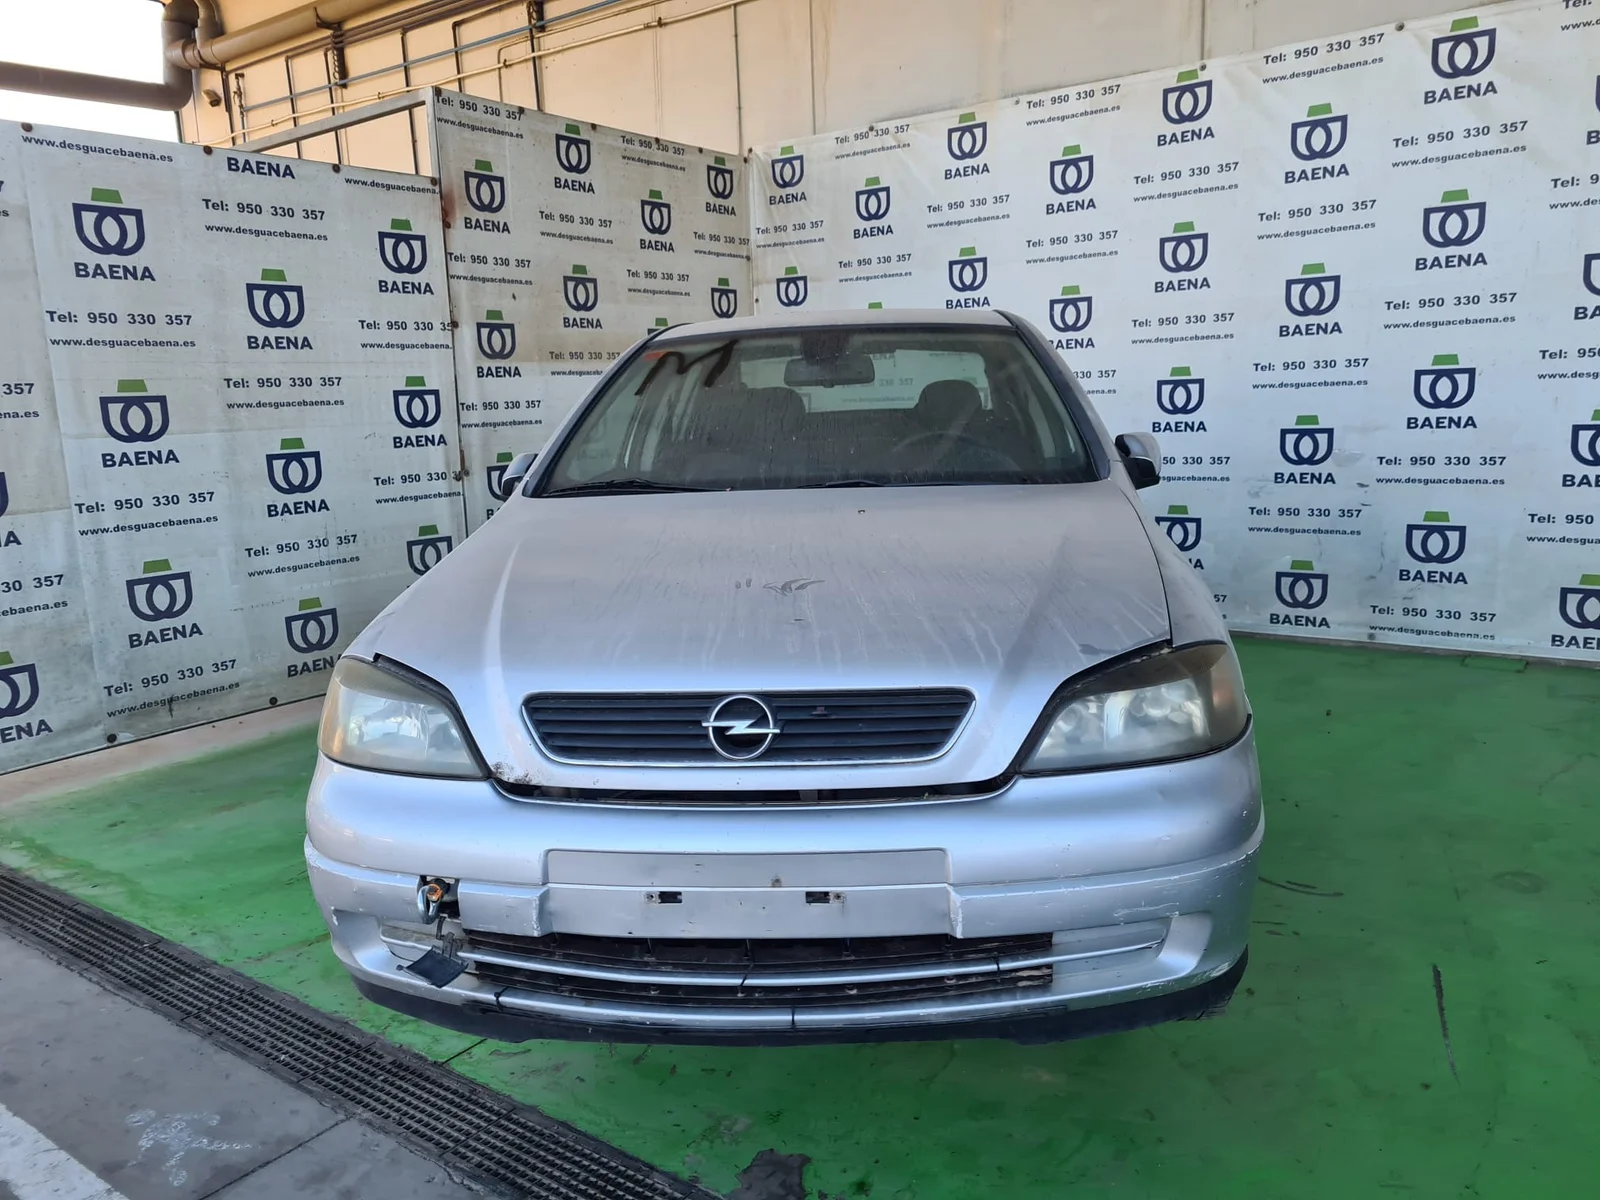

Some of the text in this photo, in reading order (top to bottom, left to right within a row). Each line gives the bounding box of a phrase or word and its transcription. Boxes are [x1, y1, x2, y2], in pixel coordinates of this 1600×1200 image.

[1263, 32, 1385, 65] Tel: 950 330 357
[1262, 57, 1384, 84] www.desguacebaena.es
[1026, 84, 1121, 109] Tel: 950 330 357
[1424, 81, 1498, 105] BAENA
[435, 95, 523, 121] Tel: 950 330 357
[1026, 105, 1120, 126] www.desguacebaena.es
[436, 115, 524, 139] www.desguacebaena.es
[1392, 120, 1528, 148] Tel: 950 330 357
[1157, 126, 1215, 147] BAENA
[21, 135, 173, 162] www.desguacebaena.es
[1391, 145, 1526, 168] www.desguacebaena.es
[226, 156, 296, 180] BAENA
[944, 163, 990, 180] BAENA
[1133, 161, 1239, 185] Tel: 950 330 357
[1284, 163, 1350, 184] BAENA
[554, 176, 595, 195] BAENA
[1133, 184, 1238, 202] www.desguacebaena.es
[769, 191, 807, 206] BAENA
[927, 194, 1010, 213] Tel: 950 330 357
[1046, 198, 1097, 215] BAENA
[201, 198, 325, 221] Tel: 950 330 357
[705, 201, 737, 217] BAENA
[1258, 199, 1377, 222] Tel: 950 330 357
[464, 216, 511, 234] BAENA
[538, 210, 612, 228] Tel: 950 330 357
[755, 220, 824, 235] Tel: 950 330 357
[927, 214, 1010, 228] www.desguacebaena.es
[204, 225, 328, 241] www.desguacebaena.es
[853, 224, 894, 240] BAENA
[1026, 230, 1118, 248] Tel: 950 330 357
[1257, 222, 1376, 240] www.desguacebaena.es
[639, 238, 675, 253] BAENA
[756, 237, 825, 249] www.desguacebaena.es
[448, 252, 531, 269] Tel: 950 330 357
[1026, 250, 1118, 264] www.desguacebaena.es
[1415, 252, 1488, 271] BAENA
[74, 262, 156, 282] BAENA
[449, 274, 533, 286] www.desguacebaena.es
[378, 279, 435, 296] BAENA
[1154, 277, 1211, 293] BAENA
[946, 296, 991, 310] BAENA
[1384, 292, 1517, 311] Tel: 950 330 357
[45, 310, 192, 326] Tel: 950 330 357
[563, 316, 603, 330] BAENA
[1131, 312, 1235, 328] Tel: 950 330 357
[1383, 316, 1516, 329] www.desguacebaena.es
[1279, 321, 1343, 338] BAENA
[49, 337, 196, 349] www.desguacebaena.es
[246, 335, 314, 350] BAENA
[1131, 333, 1234, 344] www.desguacebaena.es
[476, 365, 522, 379] BAENA
[1253, 358, 1369, 372] Tel: 950 330 357
[223, 376, 342, 389] Tel: 950 330 357
[1252, 380, 1368, 390] www.desguacebaena.es
[226, 399, 345, 410] www.desguacebaena.es
[459, 400, 541, 411] Tel: 950 330 357
[461, 419, 542, 429] www.desguacebaena.es
[1152, 420, 1207, 433] BAENA
[1406, 415, 1478, 430] BAENA
[392, 433, 448, 449] BAENA
[101, 449, 180, 468] BAENA
[1376, 456, 1507, 466] Tel: 950 330 357
[1273, 472, 1336, 485] BAENA
[1375, 476, 1505, 486] www.desguacebaena.es
[75, 491, 215, 514] Tel: 950 330 357
[266, 498, 330, 518] BAENA
[1248, 506, 1362, 518] Tel: 950 330 357
[78, 516, 218, 536] www.desguacebaena.es
[1248, 526, 1361, 536] www.desguacebaena.es
[244, 534, 357, 558] Tel: 950 330 357
[247, 556, 360, 578] www.desguacebaena.es
[1398, 569, 1468, 585] BAENA
[1269, 613, 1331, 629] BAENA
[1369, 605, 1497, 622] Tel: 950 330 357
[128, 622, 204, 649] BAENA
[1369, 625, 1495, 640] www.desguacebaena.es
[103, 658, 237, 697] Tel: 950 330 357
[106, 682, 240, 718] www.desguacebaena.es
